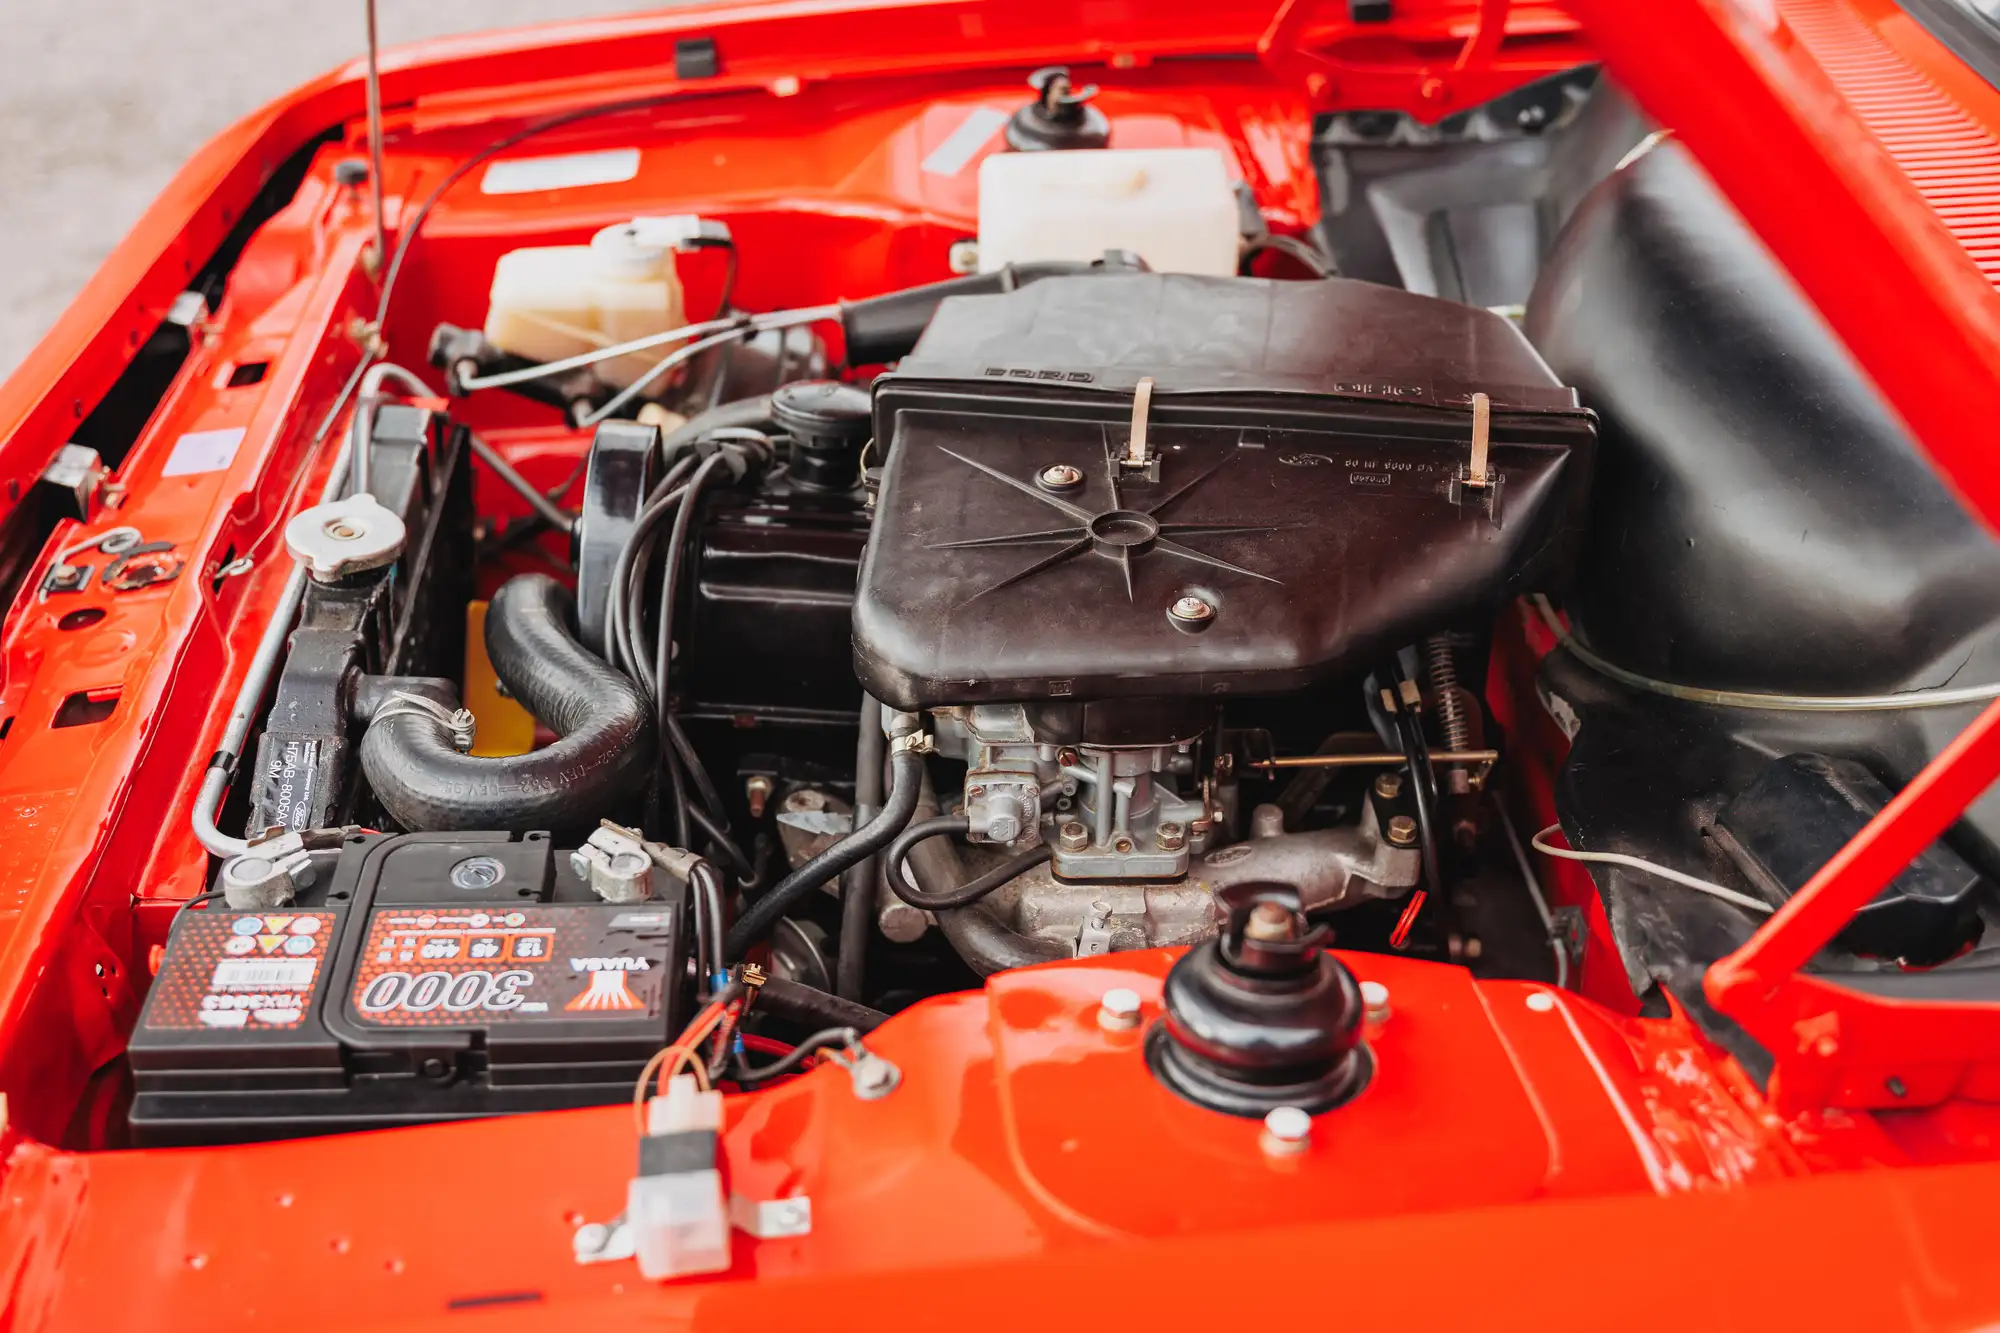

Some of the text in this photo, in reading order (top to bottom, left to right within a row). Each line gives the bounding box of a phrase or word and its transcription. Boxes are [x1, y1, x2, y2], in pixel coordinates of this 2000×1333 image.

[985, 367, 1095, 383] FORD
[268, 760, 282, 778] 9M
[293, 805, 305, 828] Ford
[421, 944, 460, 958] 440
[472, 943, 499, 958] 45
[516, 942, 543, 956] 12
[570, 956, 650, 971] YUASA
[361, 970, 534, 1011] 3000
